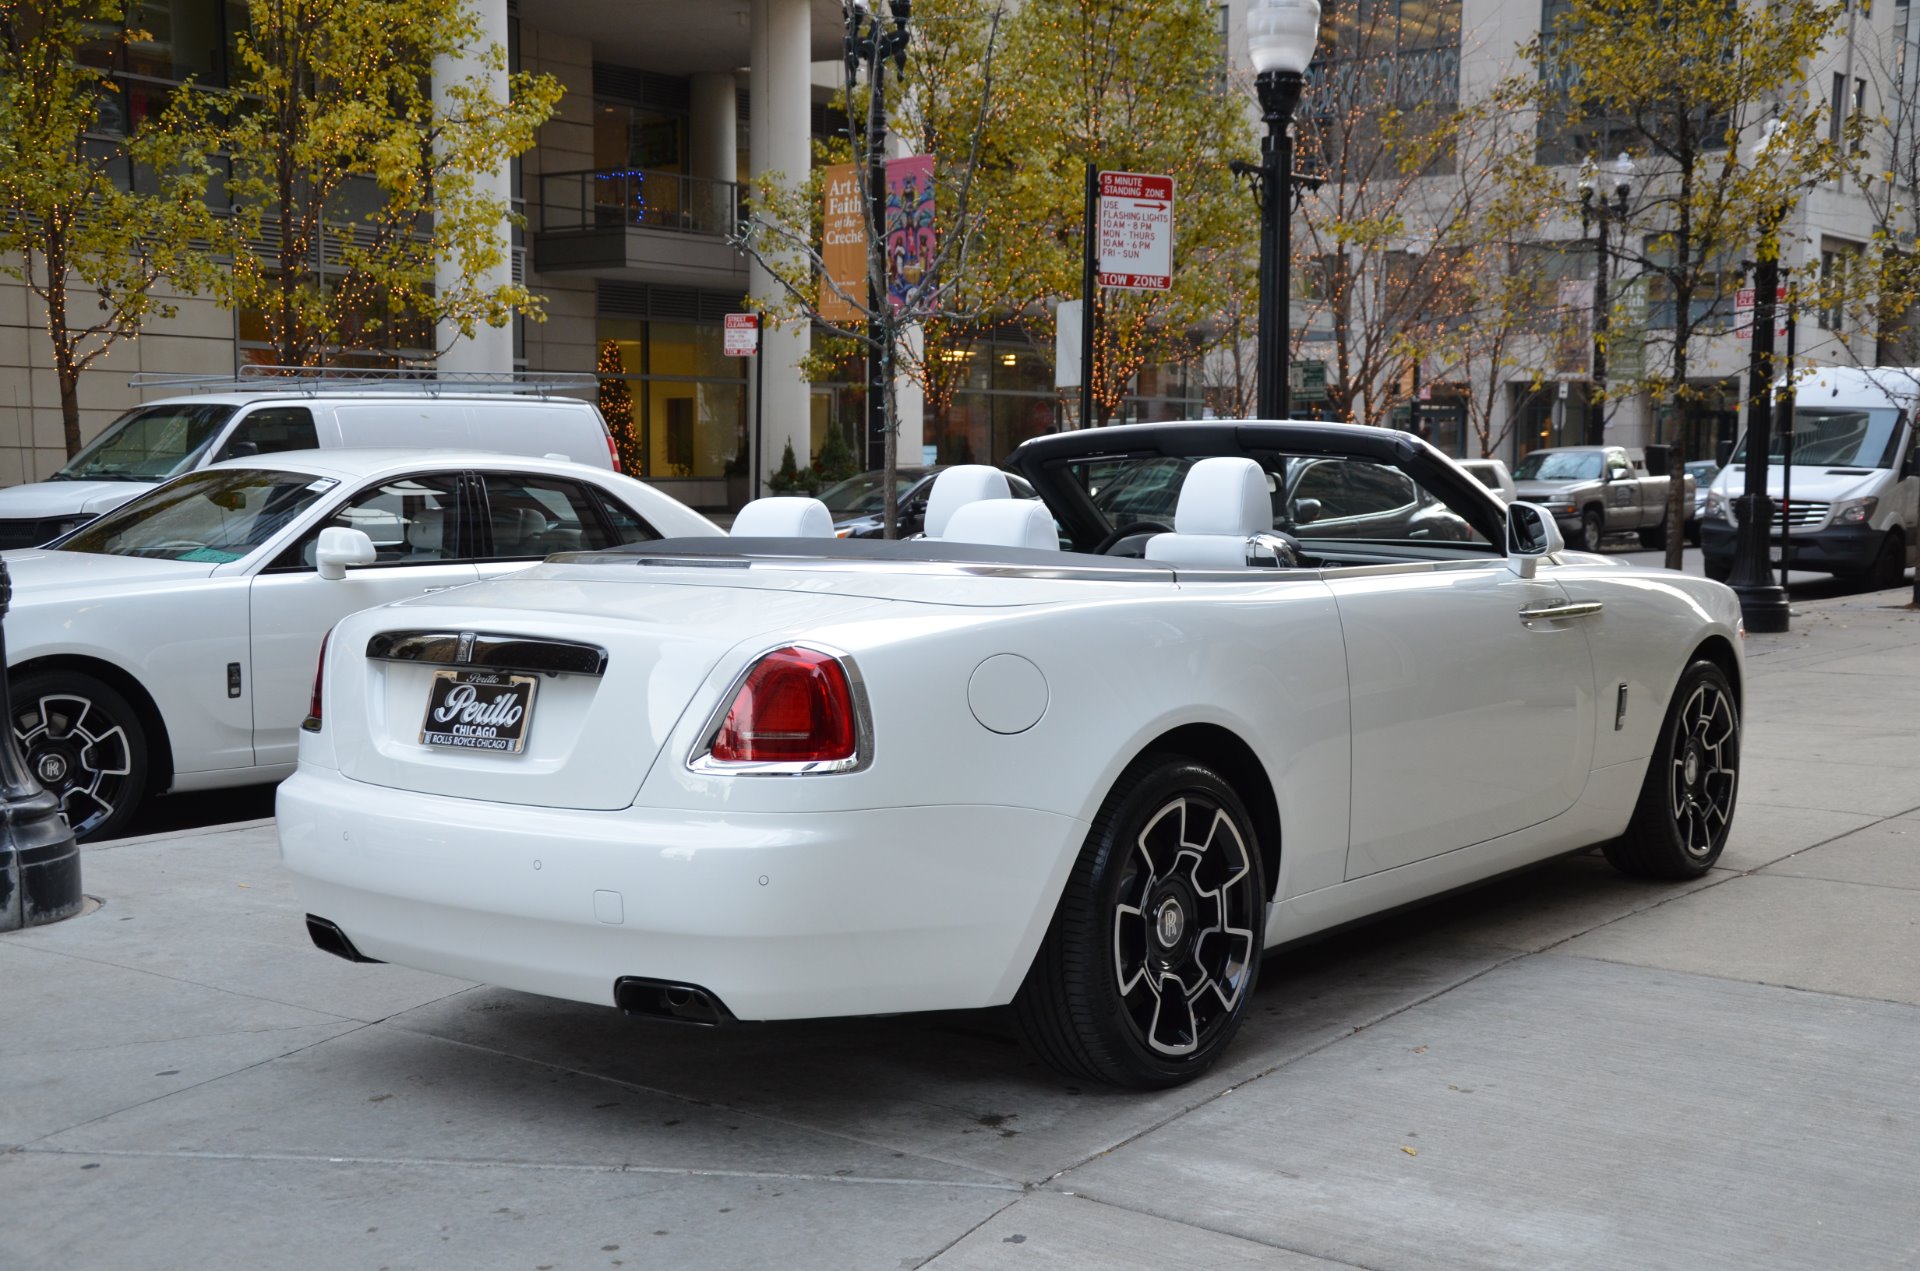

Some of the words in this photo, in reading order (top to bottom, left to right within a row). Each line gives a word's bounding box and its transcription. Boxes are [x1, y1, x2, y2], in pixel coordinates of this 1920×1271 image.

[829, 178, 851, 196] Art
[1104, 175, 1112, 185] 15
[1114, 176, 1143, 187] MINUTE
[1104, 185, 1141, 196] STANDING
[1145, 188, 1165, 198] ZONE
[829, 196, 861, 215] Faith
[1103, 200, 1119, 209] USE
[1103, 210, 1141, 221] FLASHING
[1142, 213, 1168, 223] LIGHTS
[1140, 222, 1152, 231] PM
[1103, 229, 1120, 238] MON
[1129, 231, 1155, 241] THURS
[1139, 242, 1151, 250] PM
[1102, 249, 1116, 257] FRI
[1122, 250, 1140, 259] SUN
[1102, 273, 1127, 285] TOW
[1133, 275, 1165, 287] ZONE
[466, 672, 500, 684] Perillo
[434, 684, 523, 727] Perillo
[452, 724, 497, 737] CHICAGO
[432, 734, 453, 745] ROLLS
[453, 736, 475, 747] ROYCE
[476, 738, 507, 749] CHICAGO
